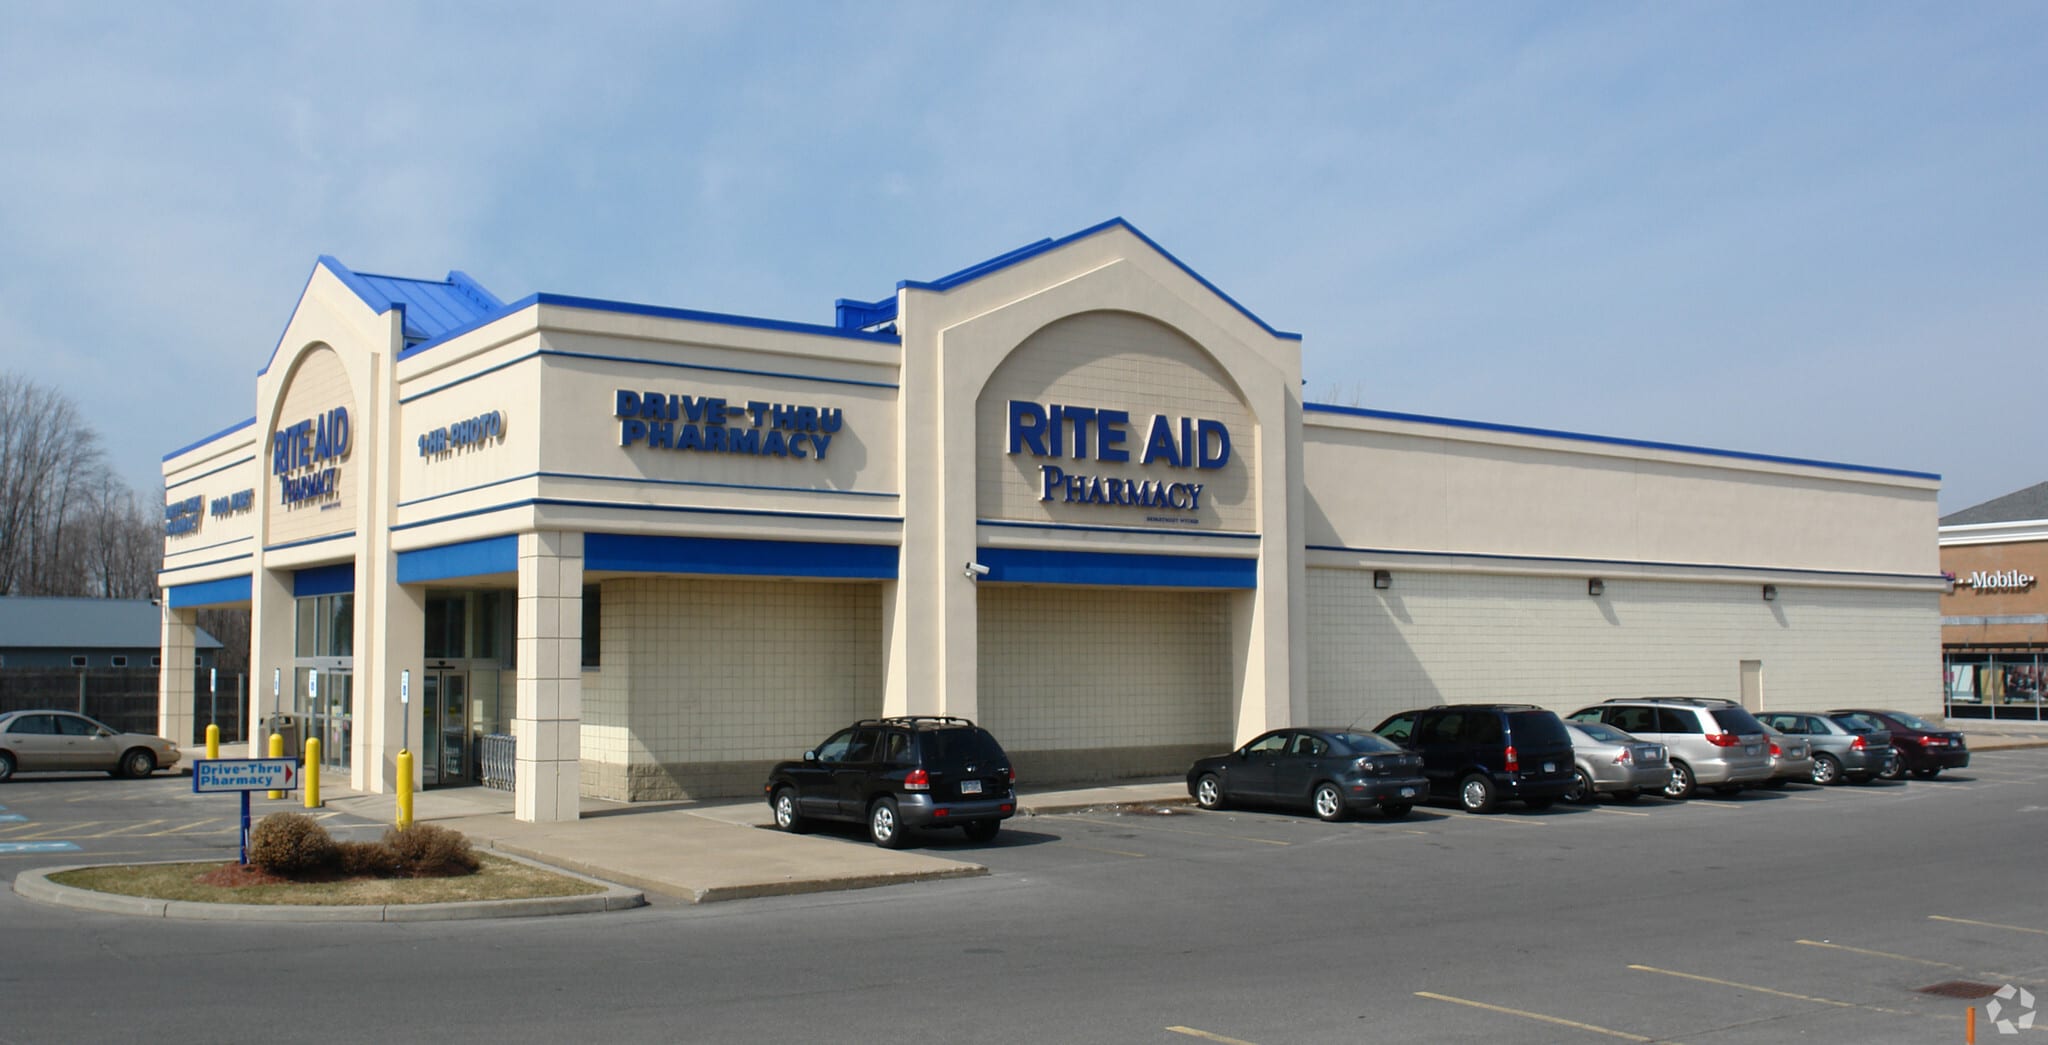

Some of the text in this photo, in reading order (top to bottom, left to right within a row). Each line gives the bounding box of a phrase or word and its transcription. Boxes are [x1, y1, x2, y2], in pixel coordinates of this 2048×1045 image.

[450, 409, 502, 449] PHOTO
[614, 389, 843, 434] DRIVE-THRU
[272, 406, 349, 476] RITE AID
[619, 419, 833, 461] PHARMACY
[1006, 400, 1232, 470] RITE AID
[280, 467, 336, 505] PHARMACY
[1038, 464, 1204, 511] PHARMACY
[200, 763, 282, 775] Drive-Thru
[200, 775, 273, 787] Pharmacy
